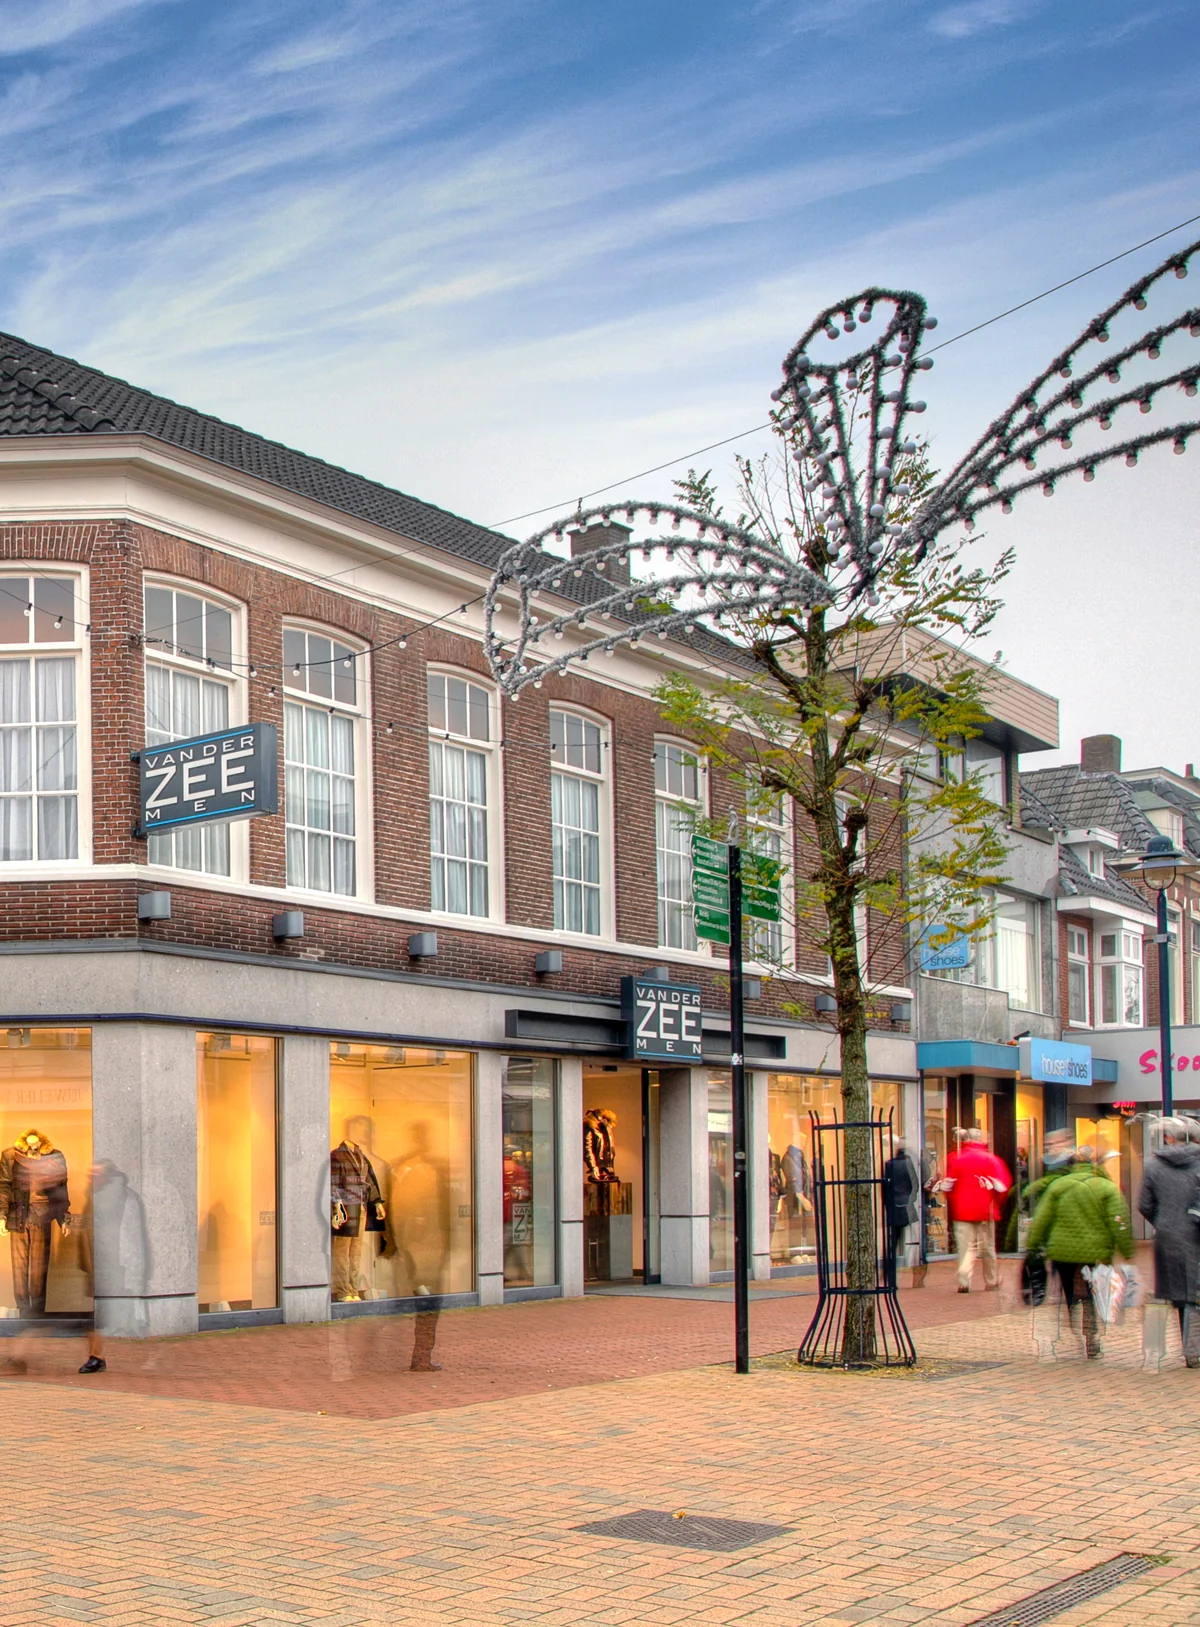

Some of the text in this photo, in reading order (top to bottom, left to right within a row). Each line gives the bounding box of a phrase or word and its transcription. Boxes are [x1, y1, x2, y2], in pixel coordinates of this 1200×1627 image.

[145, 735, 254, 769] VAN DER
[145, 748, 255, 809] ZEE
[930, 955, 965, 967] shoes
[636, 987, 701, 1005] VAN DER
[636, 1000, 701, 1042] ZEE
[1041, 1052, 1065, 1076] house
[1067, 1057, 1088, 1079] shoes
